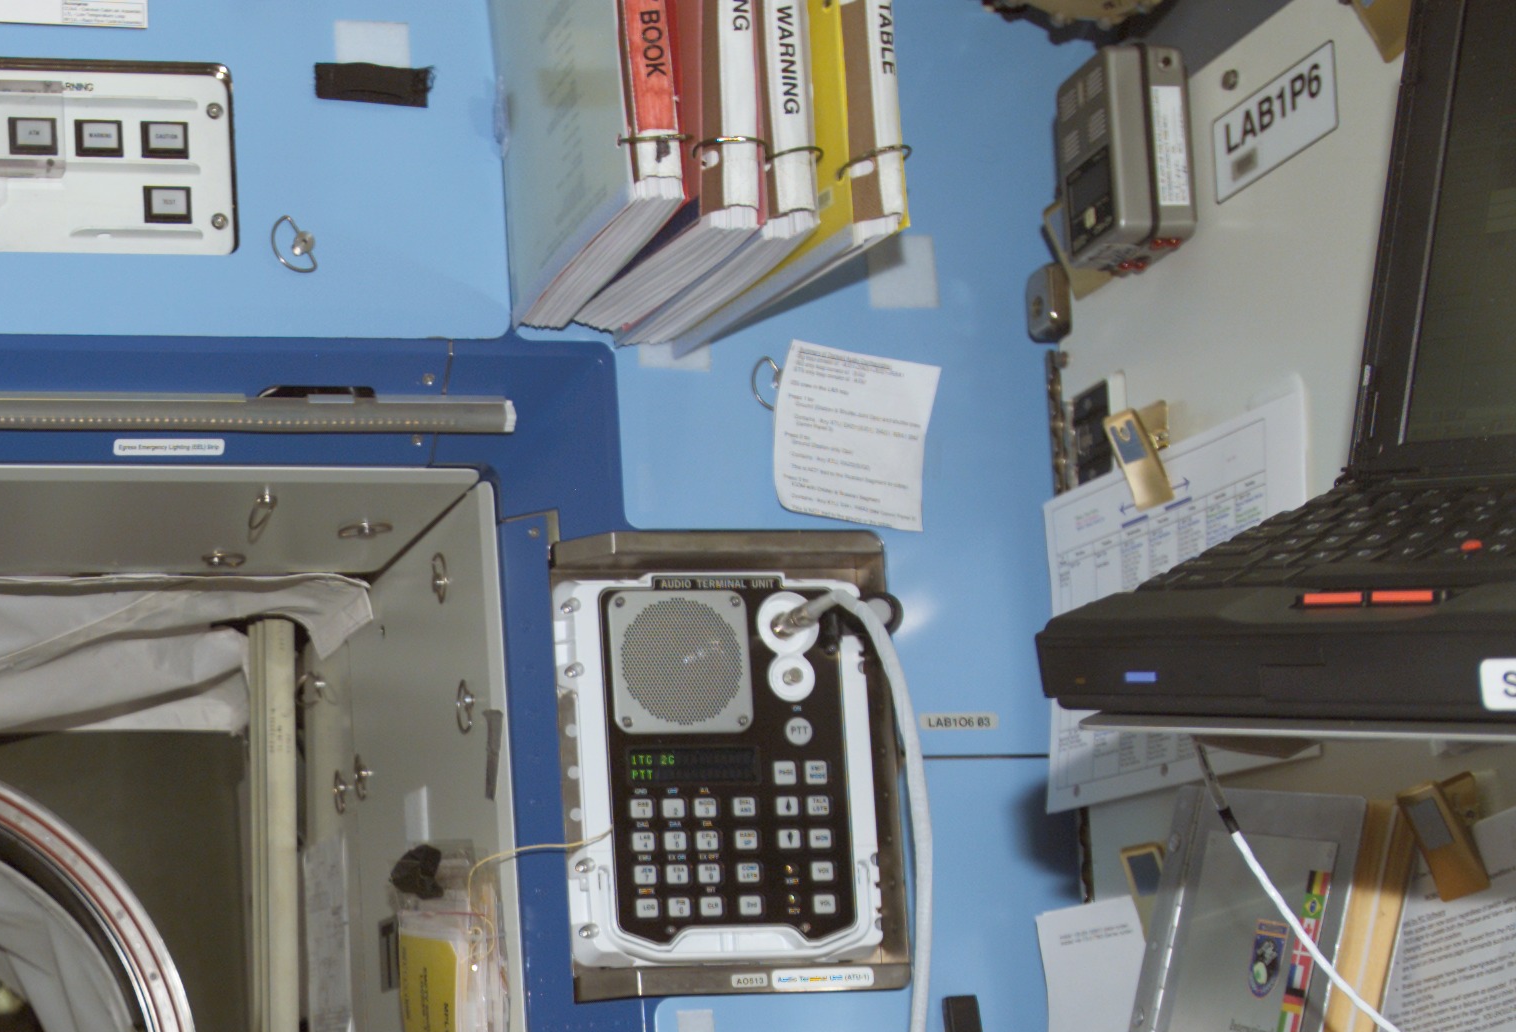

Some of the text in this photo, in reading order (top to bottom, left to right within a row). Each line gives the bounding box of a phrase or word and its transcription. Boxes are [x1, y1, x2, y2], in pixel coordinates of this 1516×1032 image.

[732, 0, 750, 32] NG
[639, 9, 667, 78] BOOK
[878, 4, 896, 75] TABLE
[776, 5, 800, 115] WARNING
[1224, 62, 1323, 155] LAB1P6
[661, 579, 774, 589] AUDIO TERMINAL UNIT
[790, 726, 809, 735] PTT
[631, 754, 653, 766] 1TG
[631, 769, 653, 781] PTT
